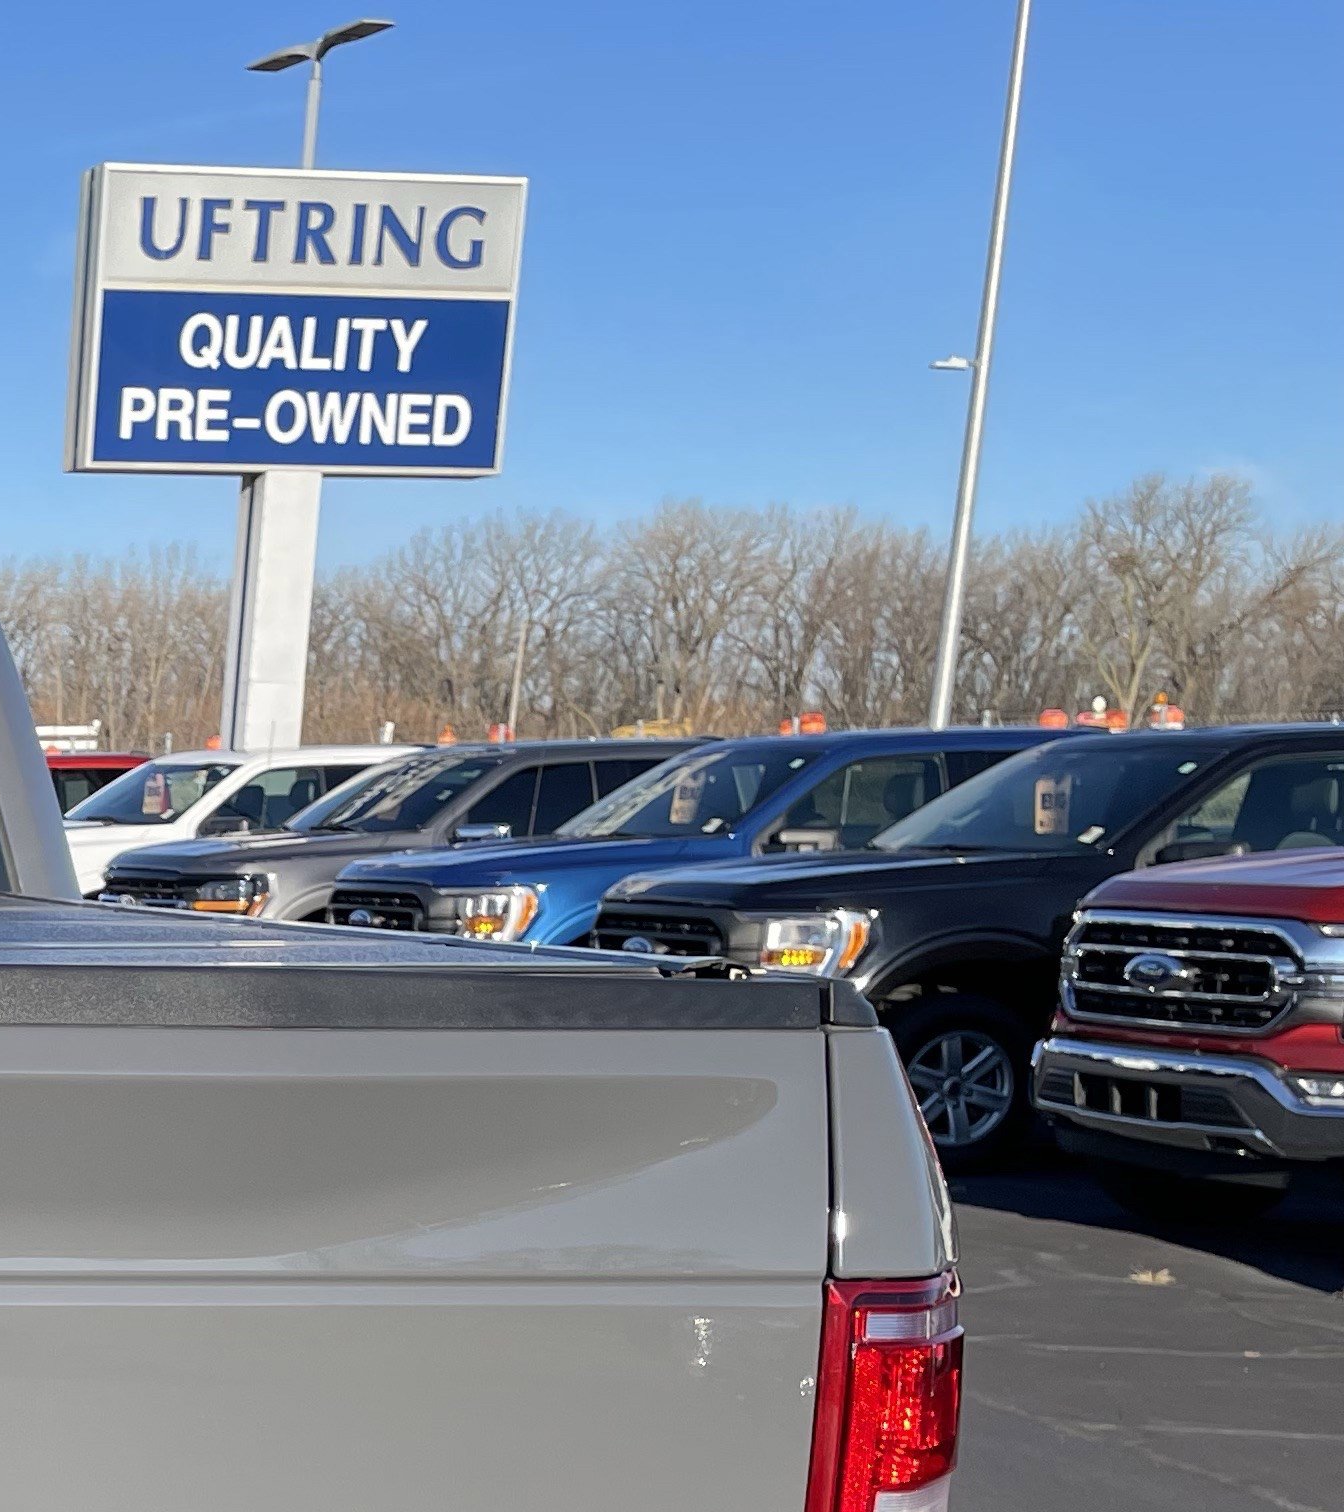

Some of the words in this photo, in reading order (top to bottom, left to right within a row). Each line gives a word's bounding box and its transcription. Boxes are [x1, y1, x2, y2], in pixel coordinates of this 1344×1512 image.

[139, 195, 487, 270] UFTRING
[179, 312, 428, 373] QUALITY
[118, 387, 472, 447] PRE-OWNED
